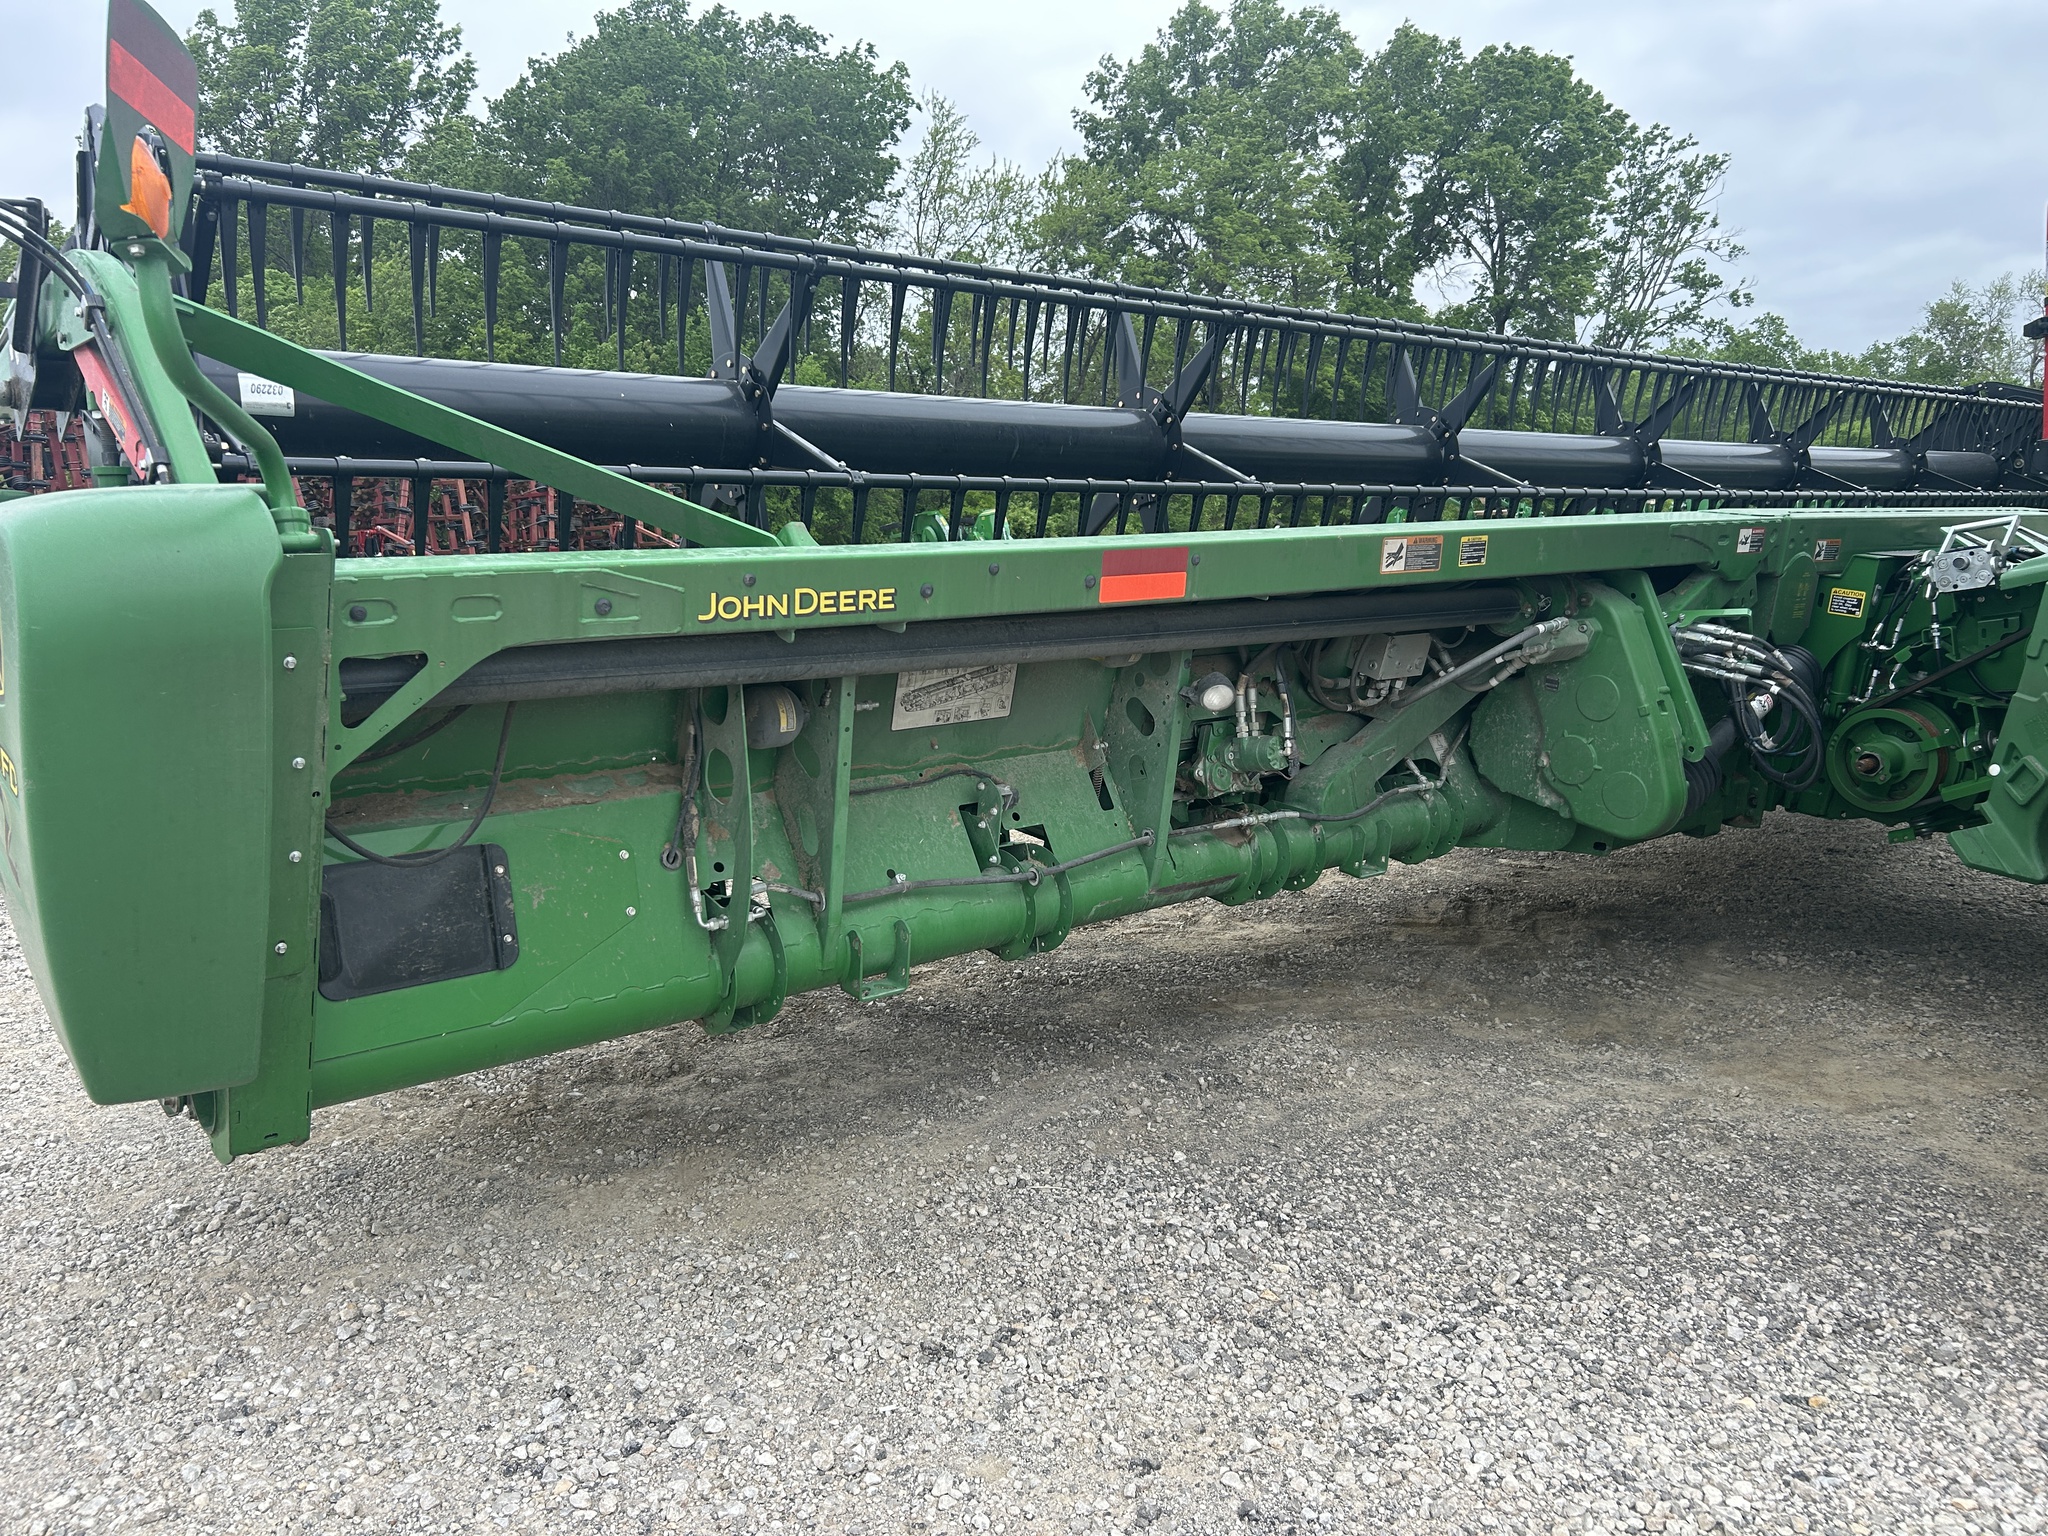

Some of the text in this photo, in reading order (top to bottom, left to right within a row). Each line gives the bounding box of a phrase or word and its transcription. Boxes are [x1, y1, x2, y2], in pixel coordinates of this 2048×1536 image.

[250, 383, 284, 396] 032290
[1837, 590, 1865, 598] CAUTION
[697, 587, 896, 621] JOHN DEERE
